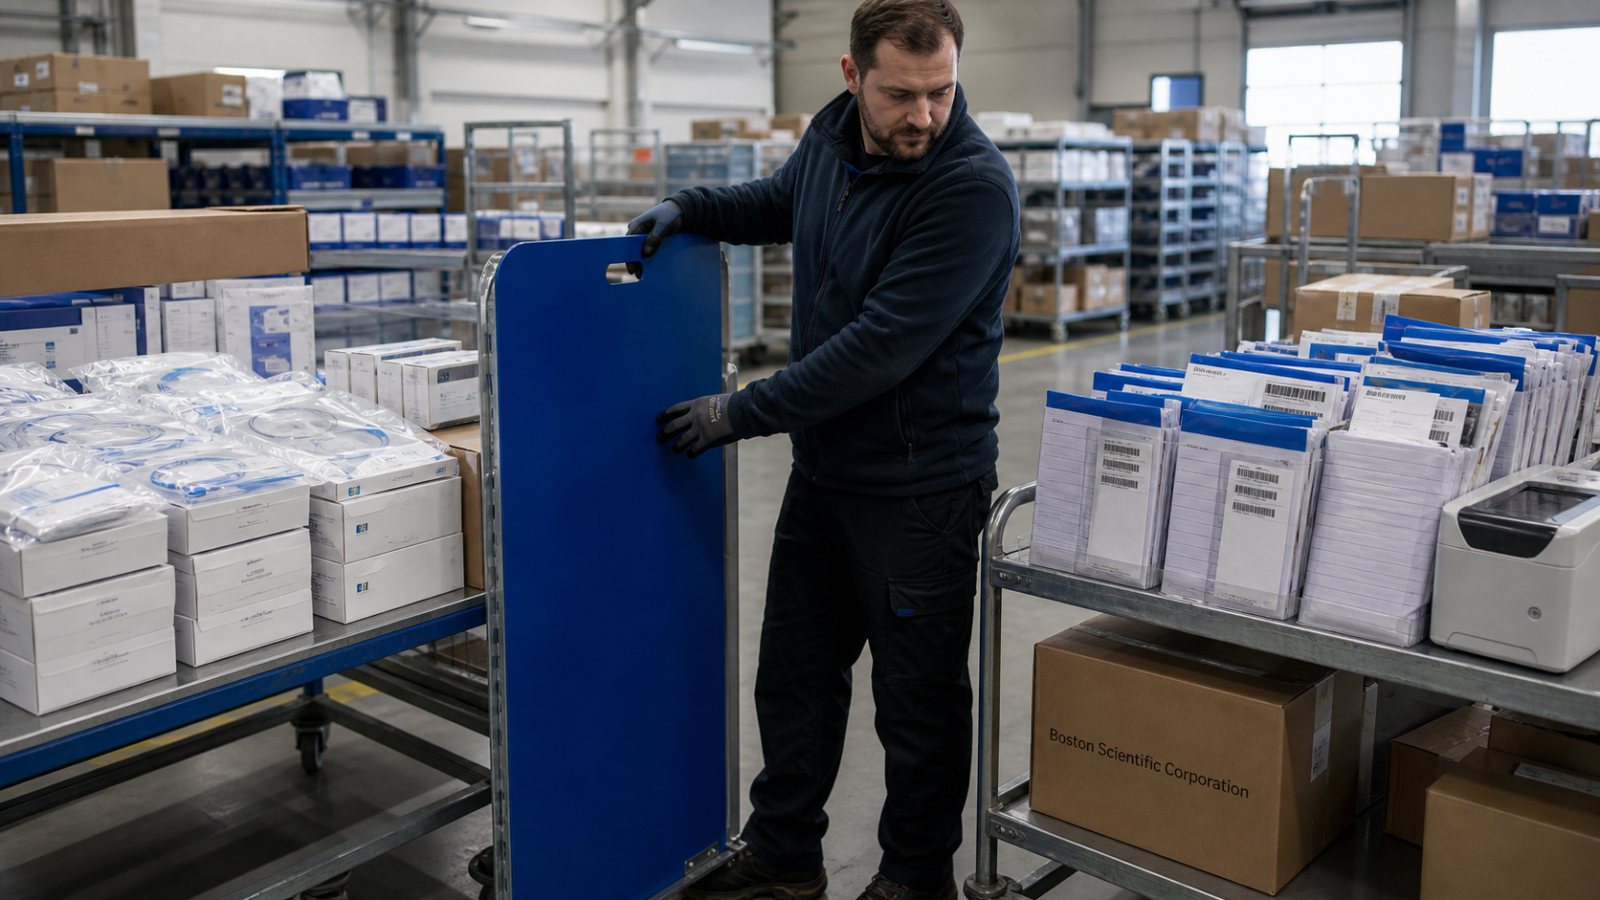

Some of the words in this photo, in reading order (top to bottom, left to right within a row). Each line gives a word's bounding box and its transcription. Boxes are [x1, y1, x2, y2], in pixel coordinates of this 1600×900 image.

[1049, 727, 1095, 753] Boston
[1097, 742, 1162, 773] Scientific
[1164, 761, 1249, 799] Corporation
